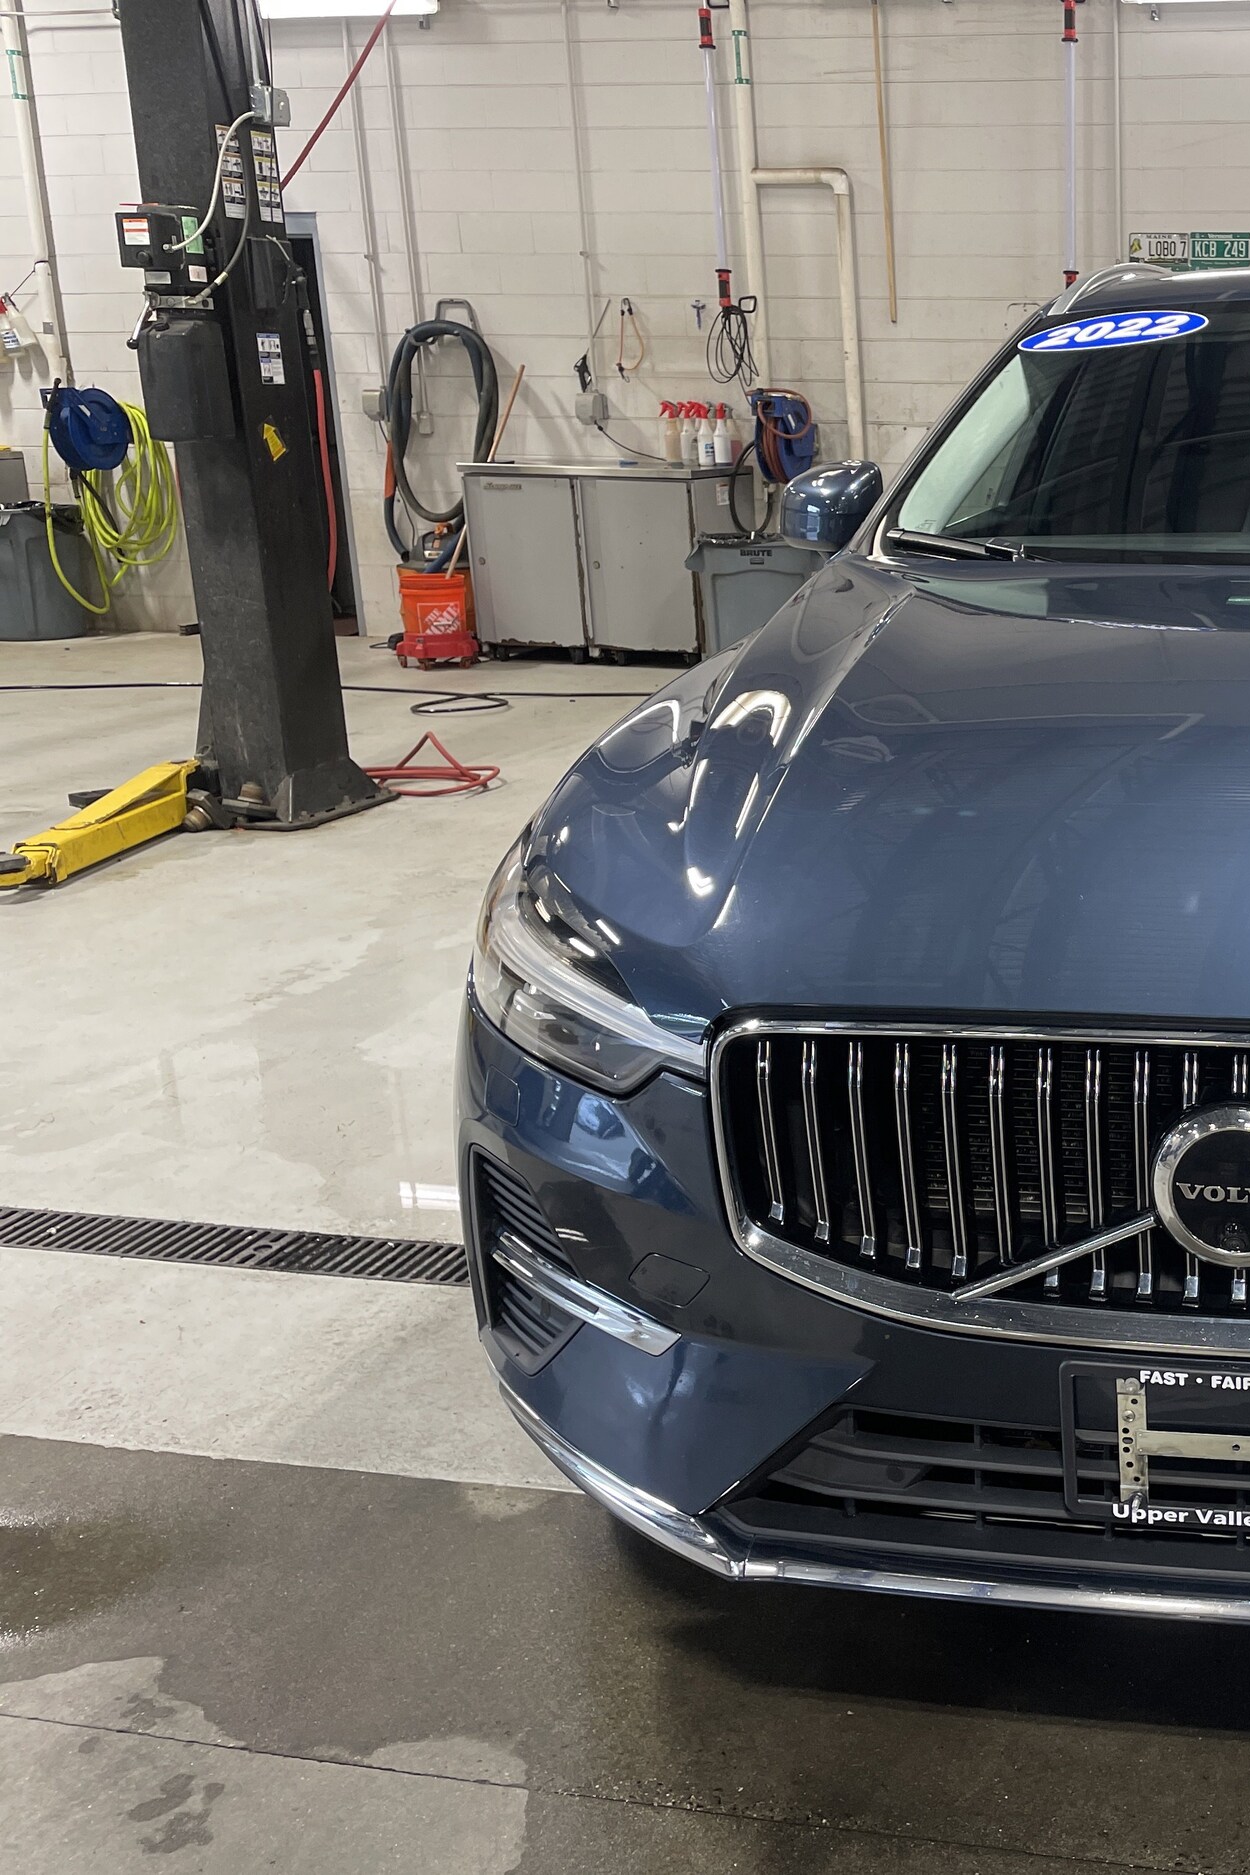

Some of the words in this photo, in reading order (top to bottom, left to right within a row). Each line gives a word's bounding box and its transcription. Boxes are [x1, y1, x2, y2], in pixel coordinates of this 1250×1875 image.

[1148, 240, 1177, 257] LOBO
[1180, 240, 1187, 257] 7
[1194, 241, 1217, 258] KCB
[1223, 241, 1246, 258] 249
[1032, 314, 1192, 349] 2022
[740, 549, 772, 557] BRUTE
[1138, 1369, 1189, 1387] FAST
[1111, 1502, 1190, 1525] Upper
